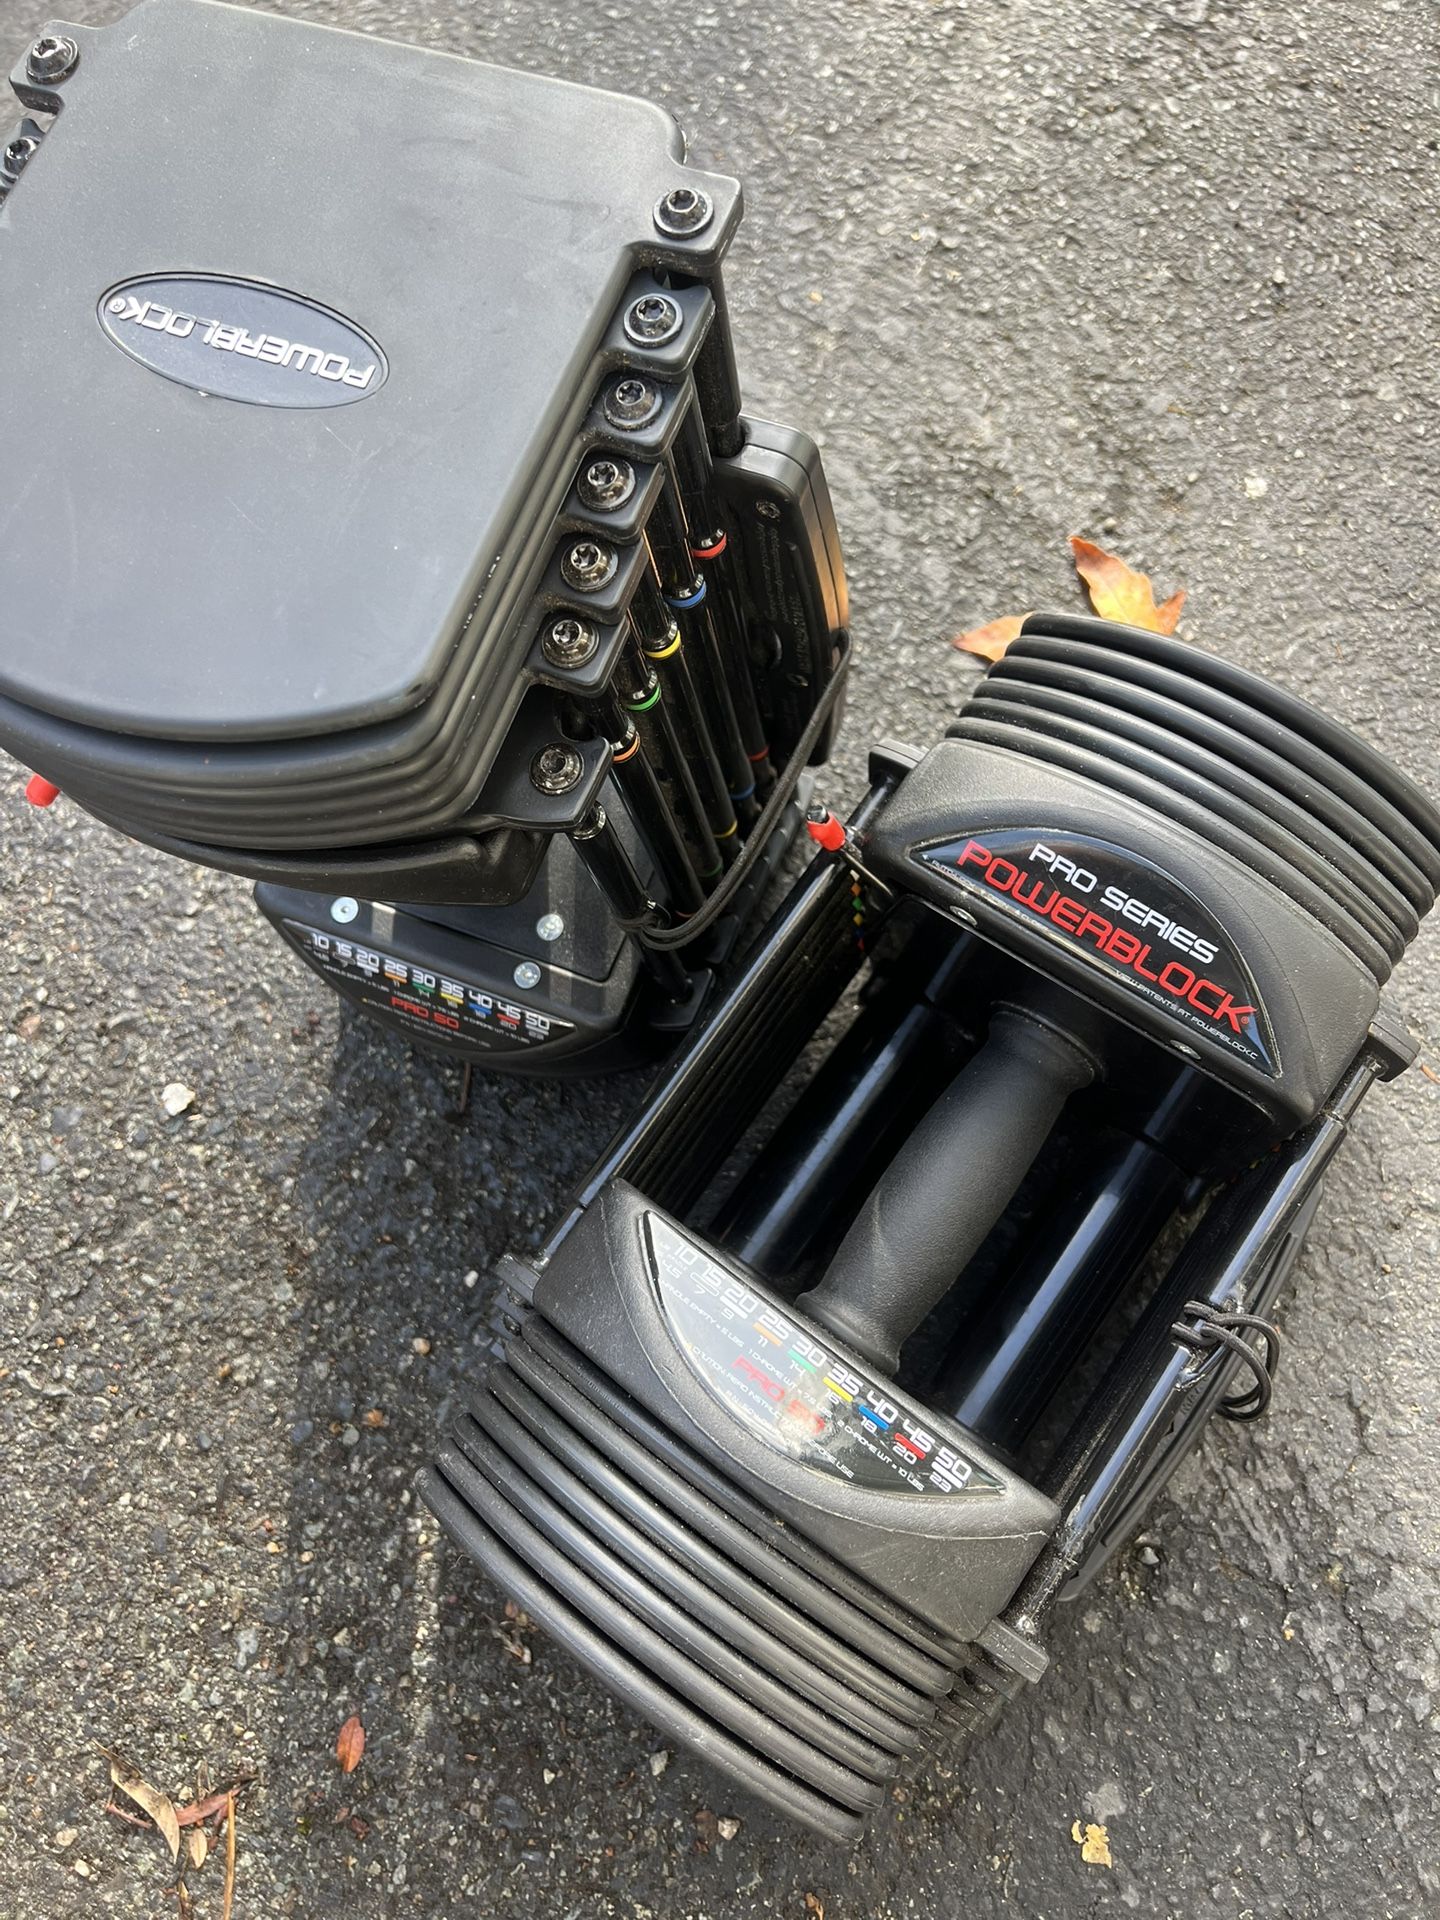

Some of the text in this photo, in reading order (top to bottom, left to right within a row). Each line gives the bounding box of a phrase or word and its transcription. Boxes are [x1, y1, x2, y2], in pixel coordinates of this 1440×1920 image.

[1028, 843, 1219, 964] PRO SERIES
[311, 933, 330, 950] 10
[336, 942, 353, 958] 15
[356, 948, 380, 967] 20
[384, 959, 408, 978] 25
[412, 969, 436, 988] 30
[440, 979, 464, 998] 35
[468, 990, 492, 1010] 40
[497, 1001, 521, 1020] 45
[525, 1011, 550, 1031] 50
[391, 997, 430, 1019] PRO
[433, 1012, 460, 1031] 50
[1140, 983, 1179, 1012] PATENTS
[1177, 1007, 1192, 1018] AT
[674, 1243, 698, 1266] 10
[702, 1262, 726, 1287] 15
[724, 1282, 760, 1313] 20
[758, 1309, 793, 1340] 25
[791, 1335, 828, 1368] 30
[827, 1362, 864, 1396] 35
[866, 1390, 899, 1424] 40
[902, 1418, 936, 1453] 45
[934, 1446, 973, 1481] 50
[694, 1284, 706, 1294] 7
[720, 1307, 735, 1320] 9
[757, 1335, 769, 1348] 11
[789, 1360, 807, 1376] 14
[825, 1388, 841, 1405] 16
[861, 1415, 878, 1434] 18
[892, 1441, 917, 1465] 20
[929, 1471, 952, 1493] 23
[730, 1353, 785, 1402] PRO
[835, 1460, 855, 1479] USE
[843, 1425, 878, 1454] CHROME
[876, 1450, 893, 1464] WT
[898, 1466, 908, 1478] 10
[906, 1474, 925, 1492] LBS
